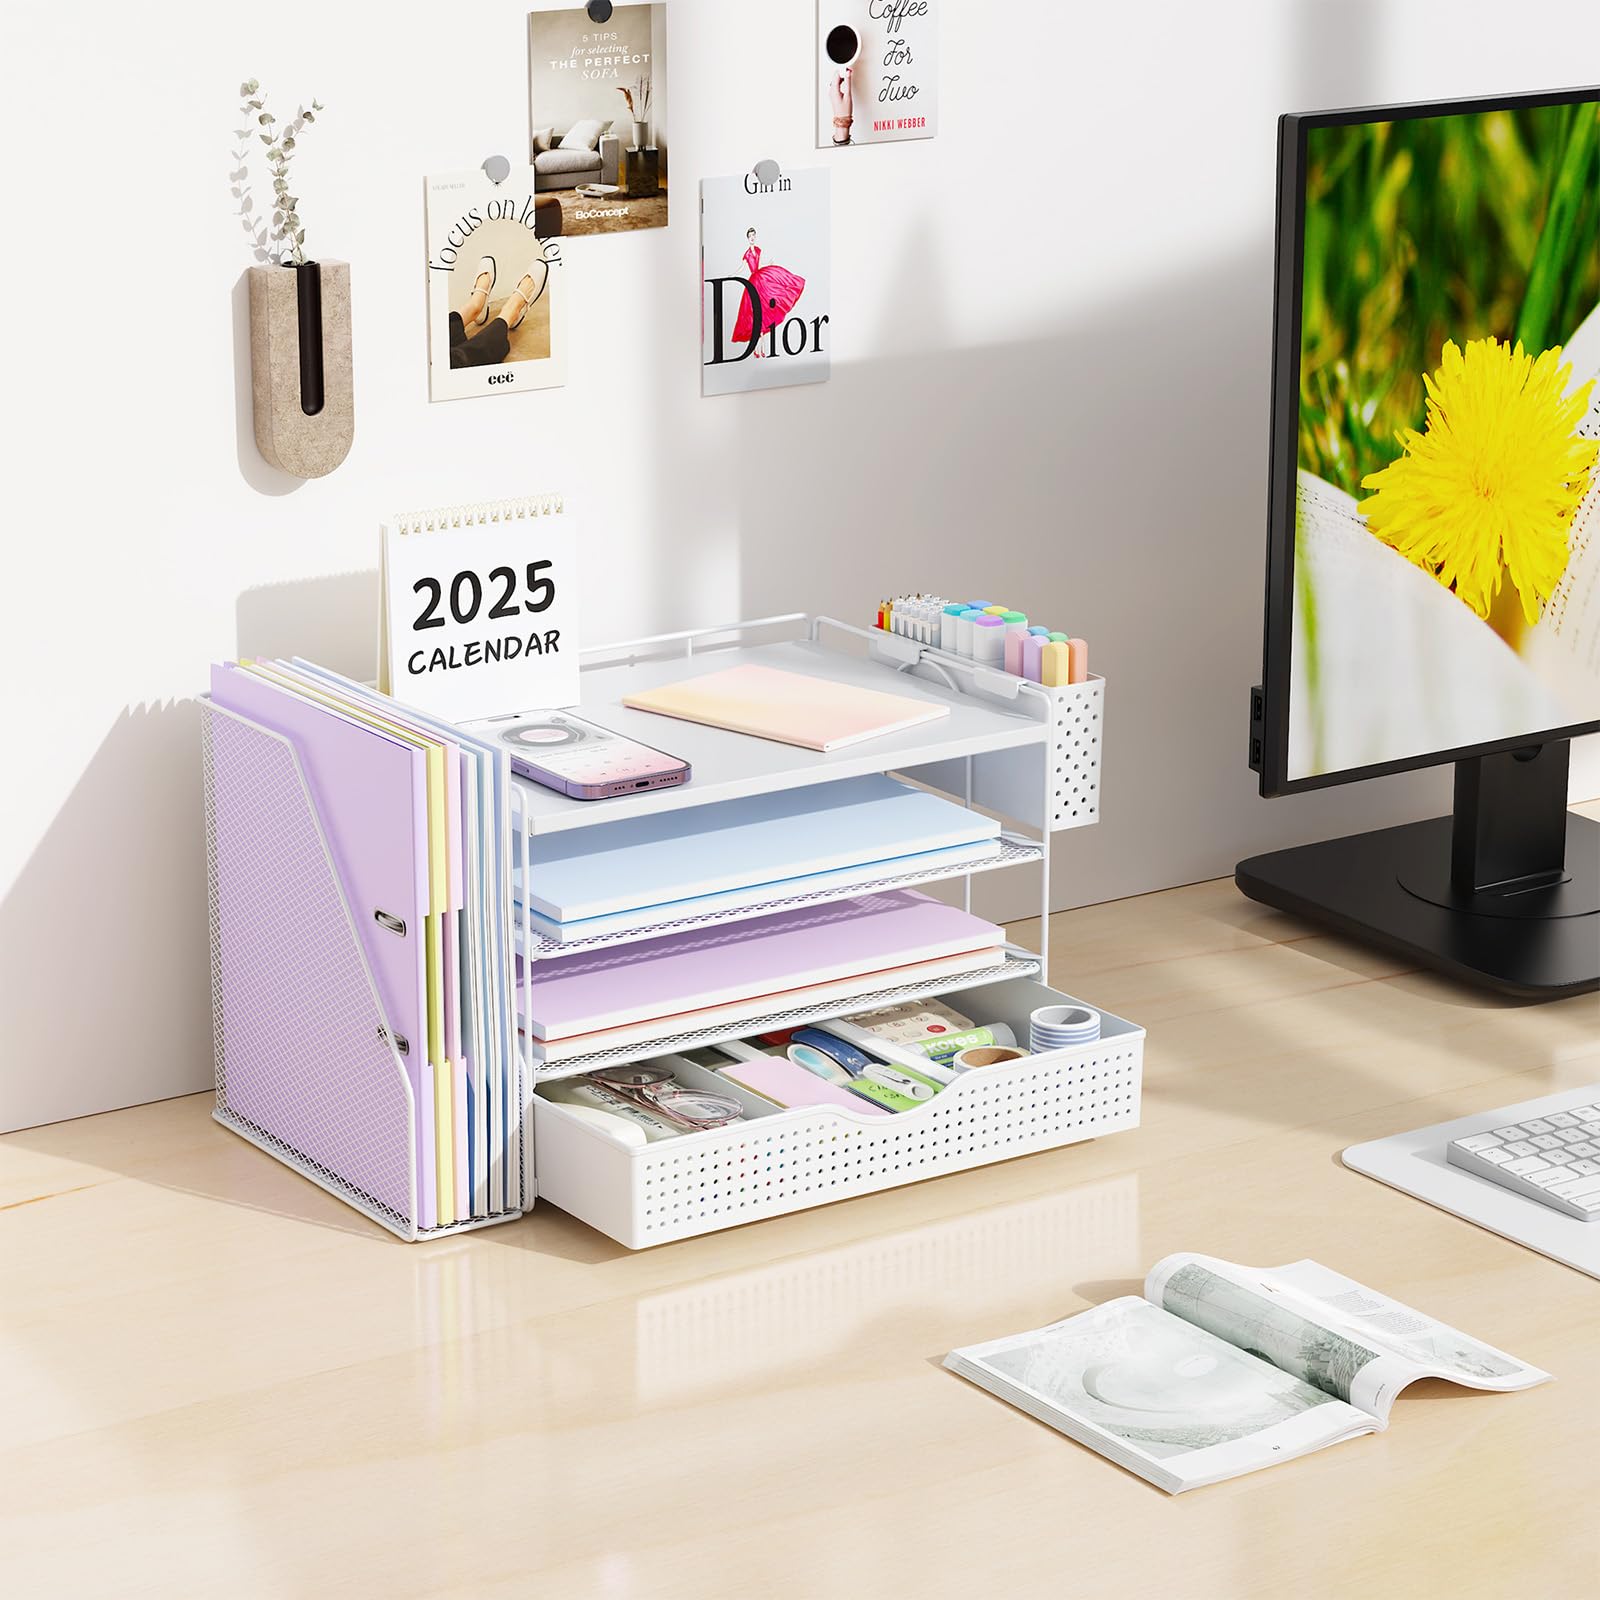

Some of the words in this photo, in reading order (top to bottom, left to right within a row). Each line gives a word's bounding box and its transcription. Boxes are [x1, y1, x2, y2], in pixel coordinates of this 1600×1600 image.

[868, 0, 928, 33] Coffee
[582, 34, 589, 42] 5
[593, 32, 618, 41] TIPS
[550, 60, 577, 69] THE
[584, 54, 650, 67] PERFECT
[571, 46, 587, 58] for
[587, 43, 629, 55] selecting
[883, 39, 913, 66] For
[582, 68, 619, 80] SOFA
[878, 75, 920, 102] Two
[873, 119, 895, 131] NIKKI
[897, 117, 926, 129] WEBBER
[779, 173, 792, 191] in
[575, 206, 629, 220] BoConcept
[429, 207, 482, 271] focus
[487, 199, 515, 221] on
[703, 276, 829, 365] Dior
[412, 559, 556, 631] 2025
[407, 629, 561, 675] CALENDAR
